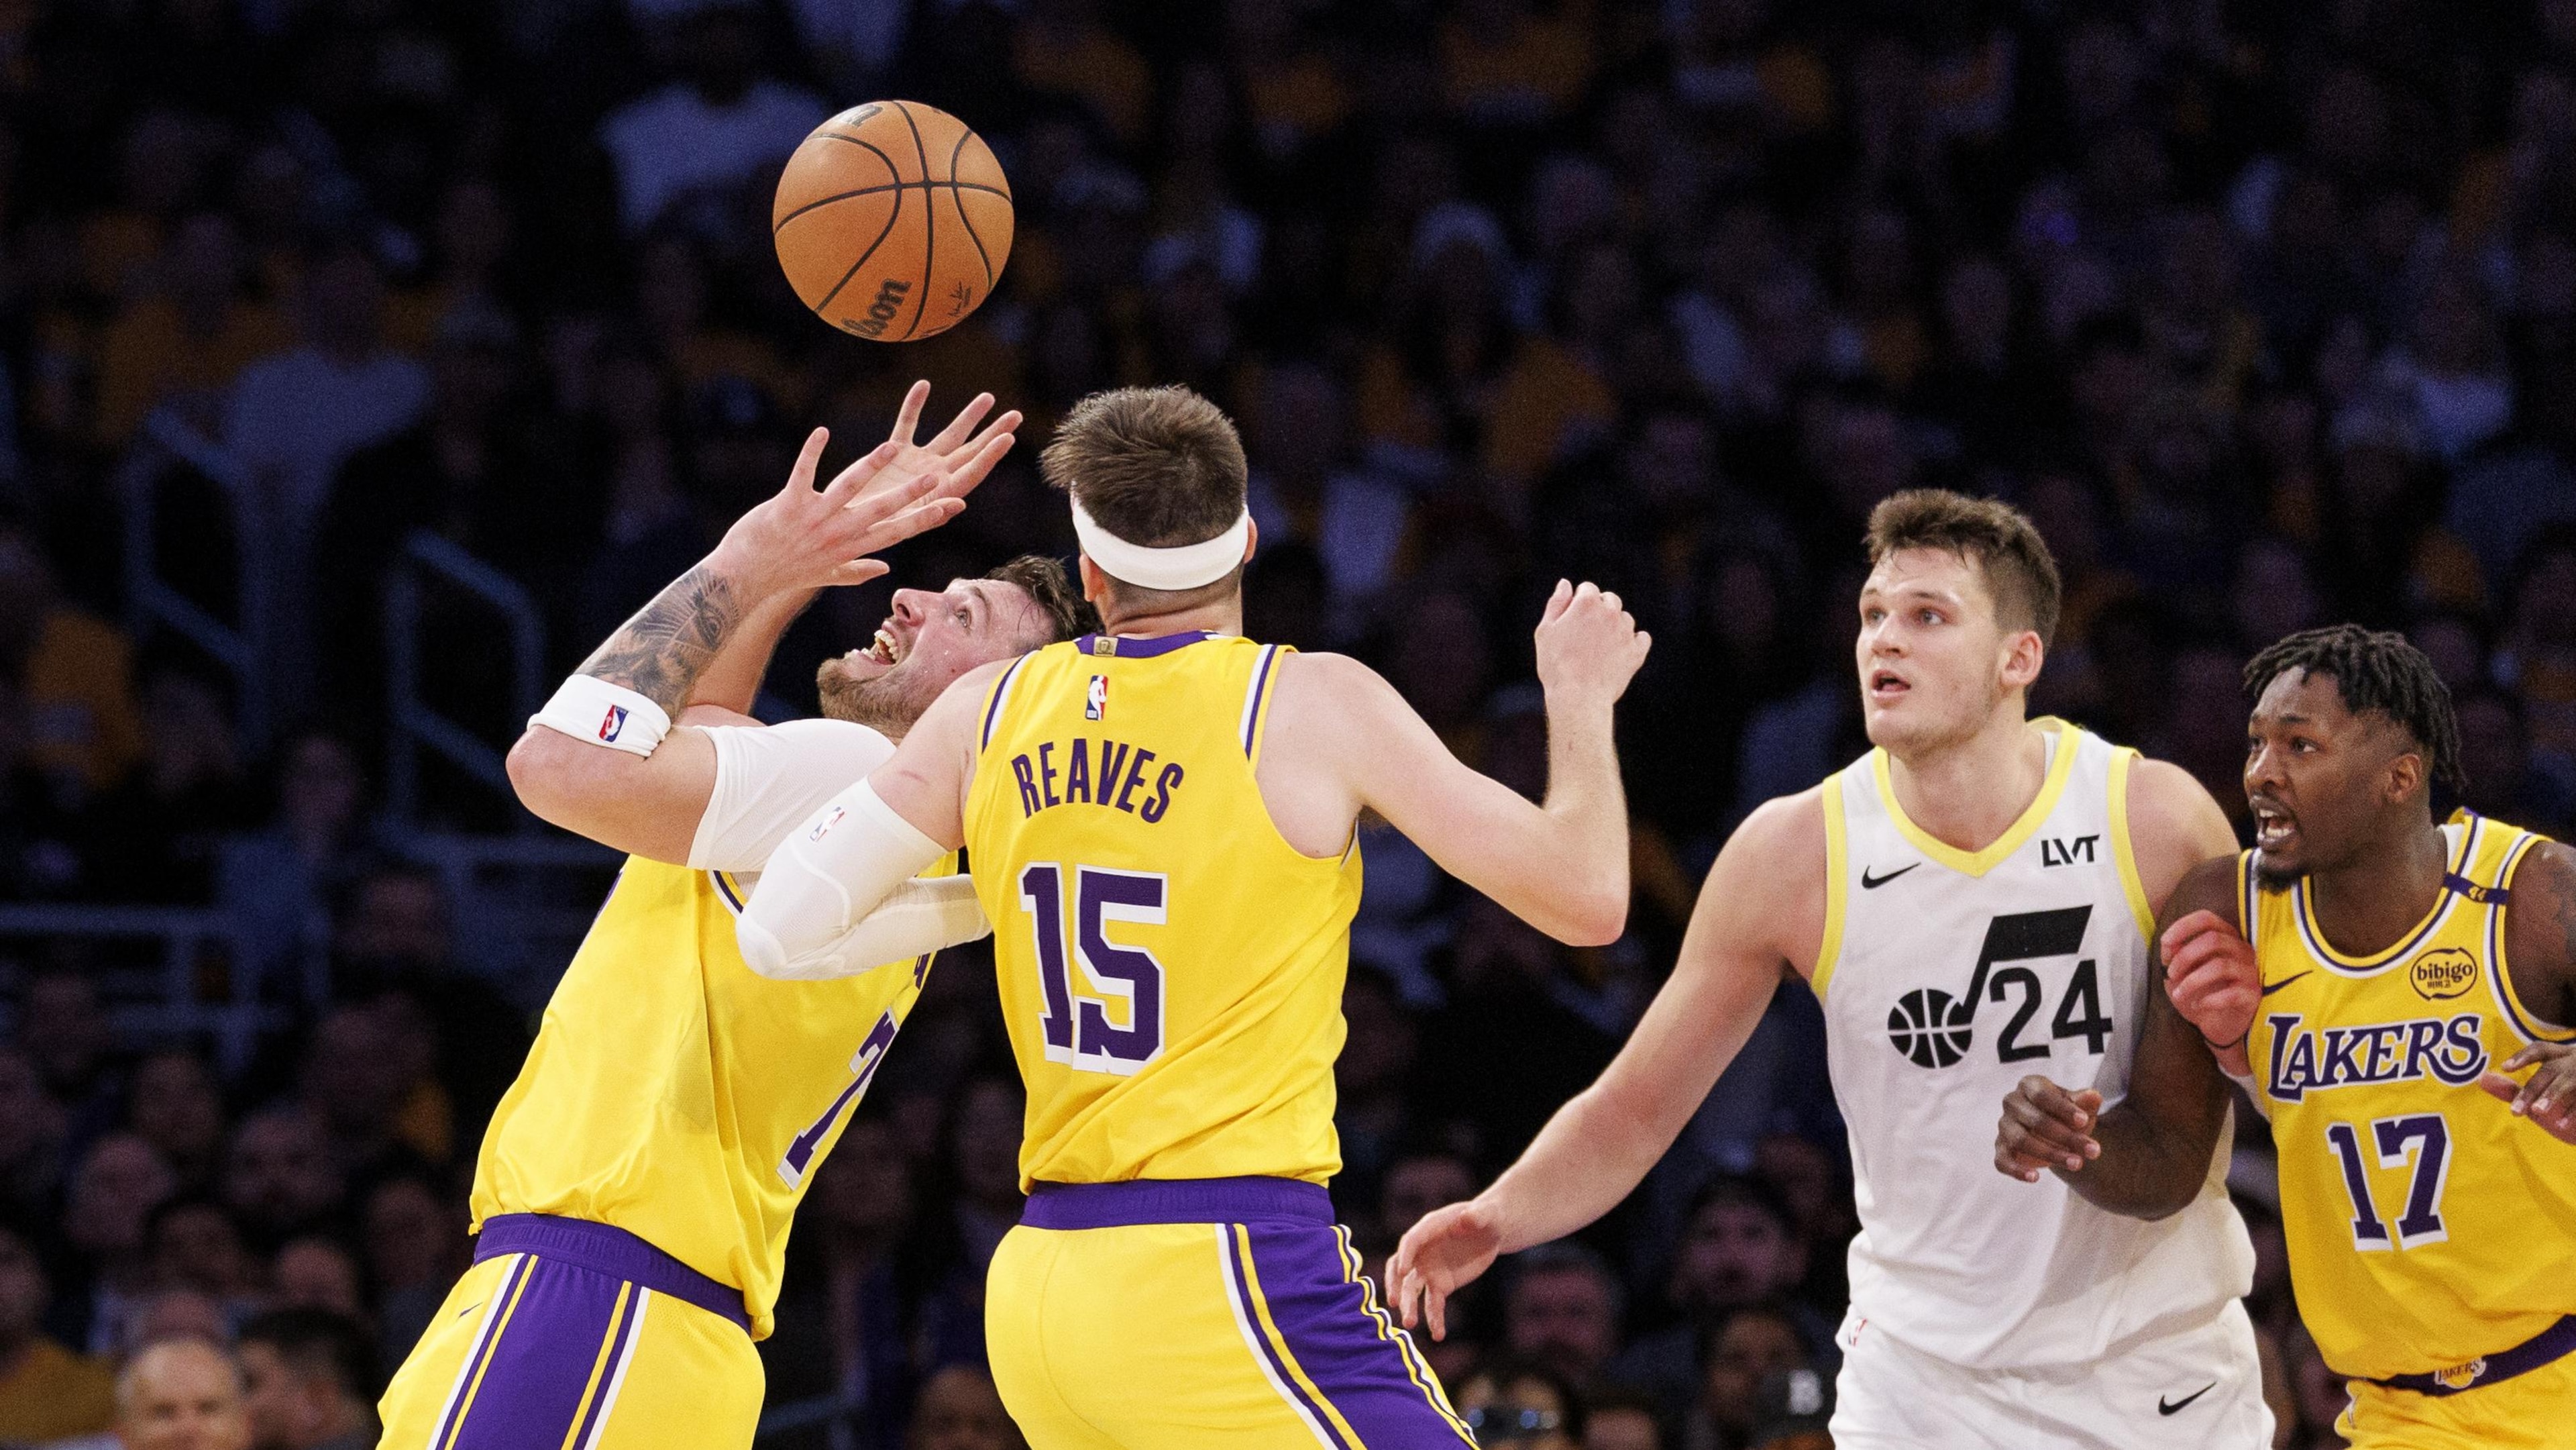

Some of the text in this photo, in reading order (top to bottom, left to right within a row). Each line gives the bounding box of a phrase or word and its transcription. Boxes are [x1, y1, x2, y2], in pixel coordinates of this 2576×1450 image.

[1011, 738, 1185, 824] REAVES
[2041, 835, 2100, 867] LVT
[1017, 862, 1167, 1076] 15
[1989, 959, 2113, 1064] 24
[2417, 962, 2473, 983] bibigo
[2265, 1012, 2489, 1104] LAKERS
[2325, 1112, 2453, 1252] 17
